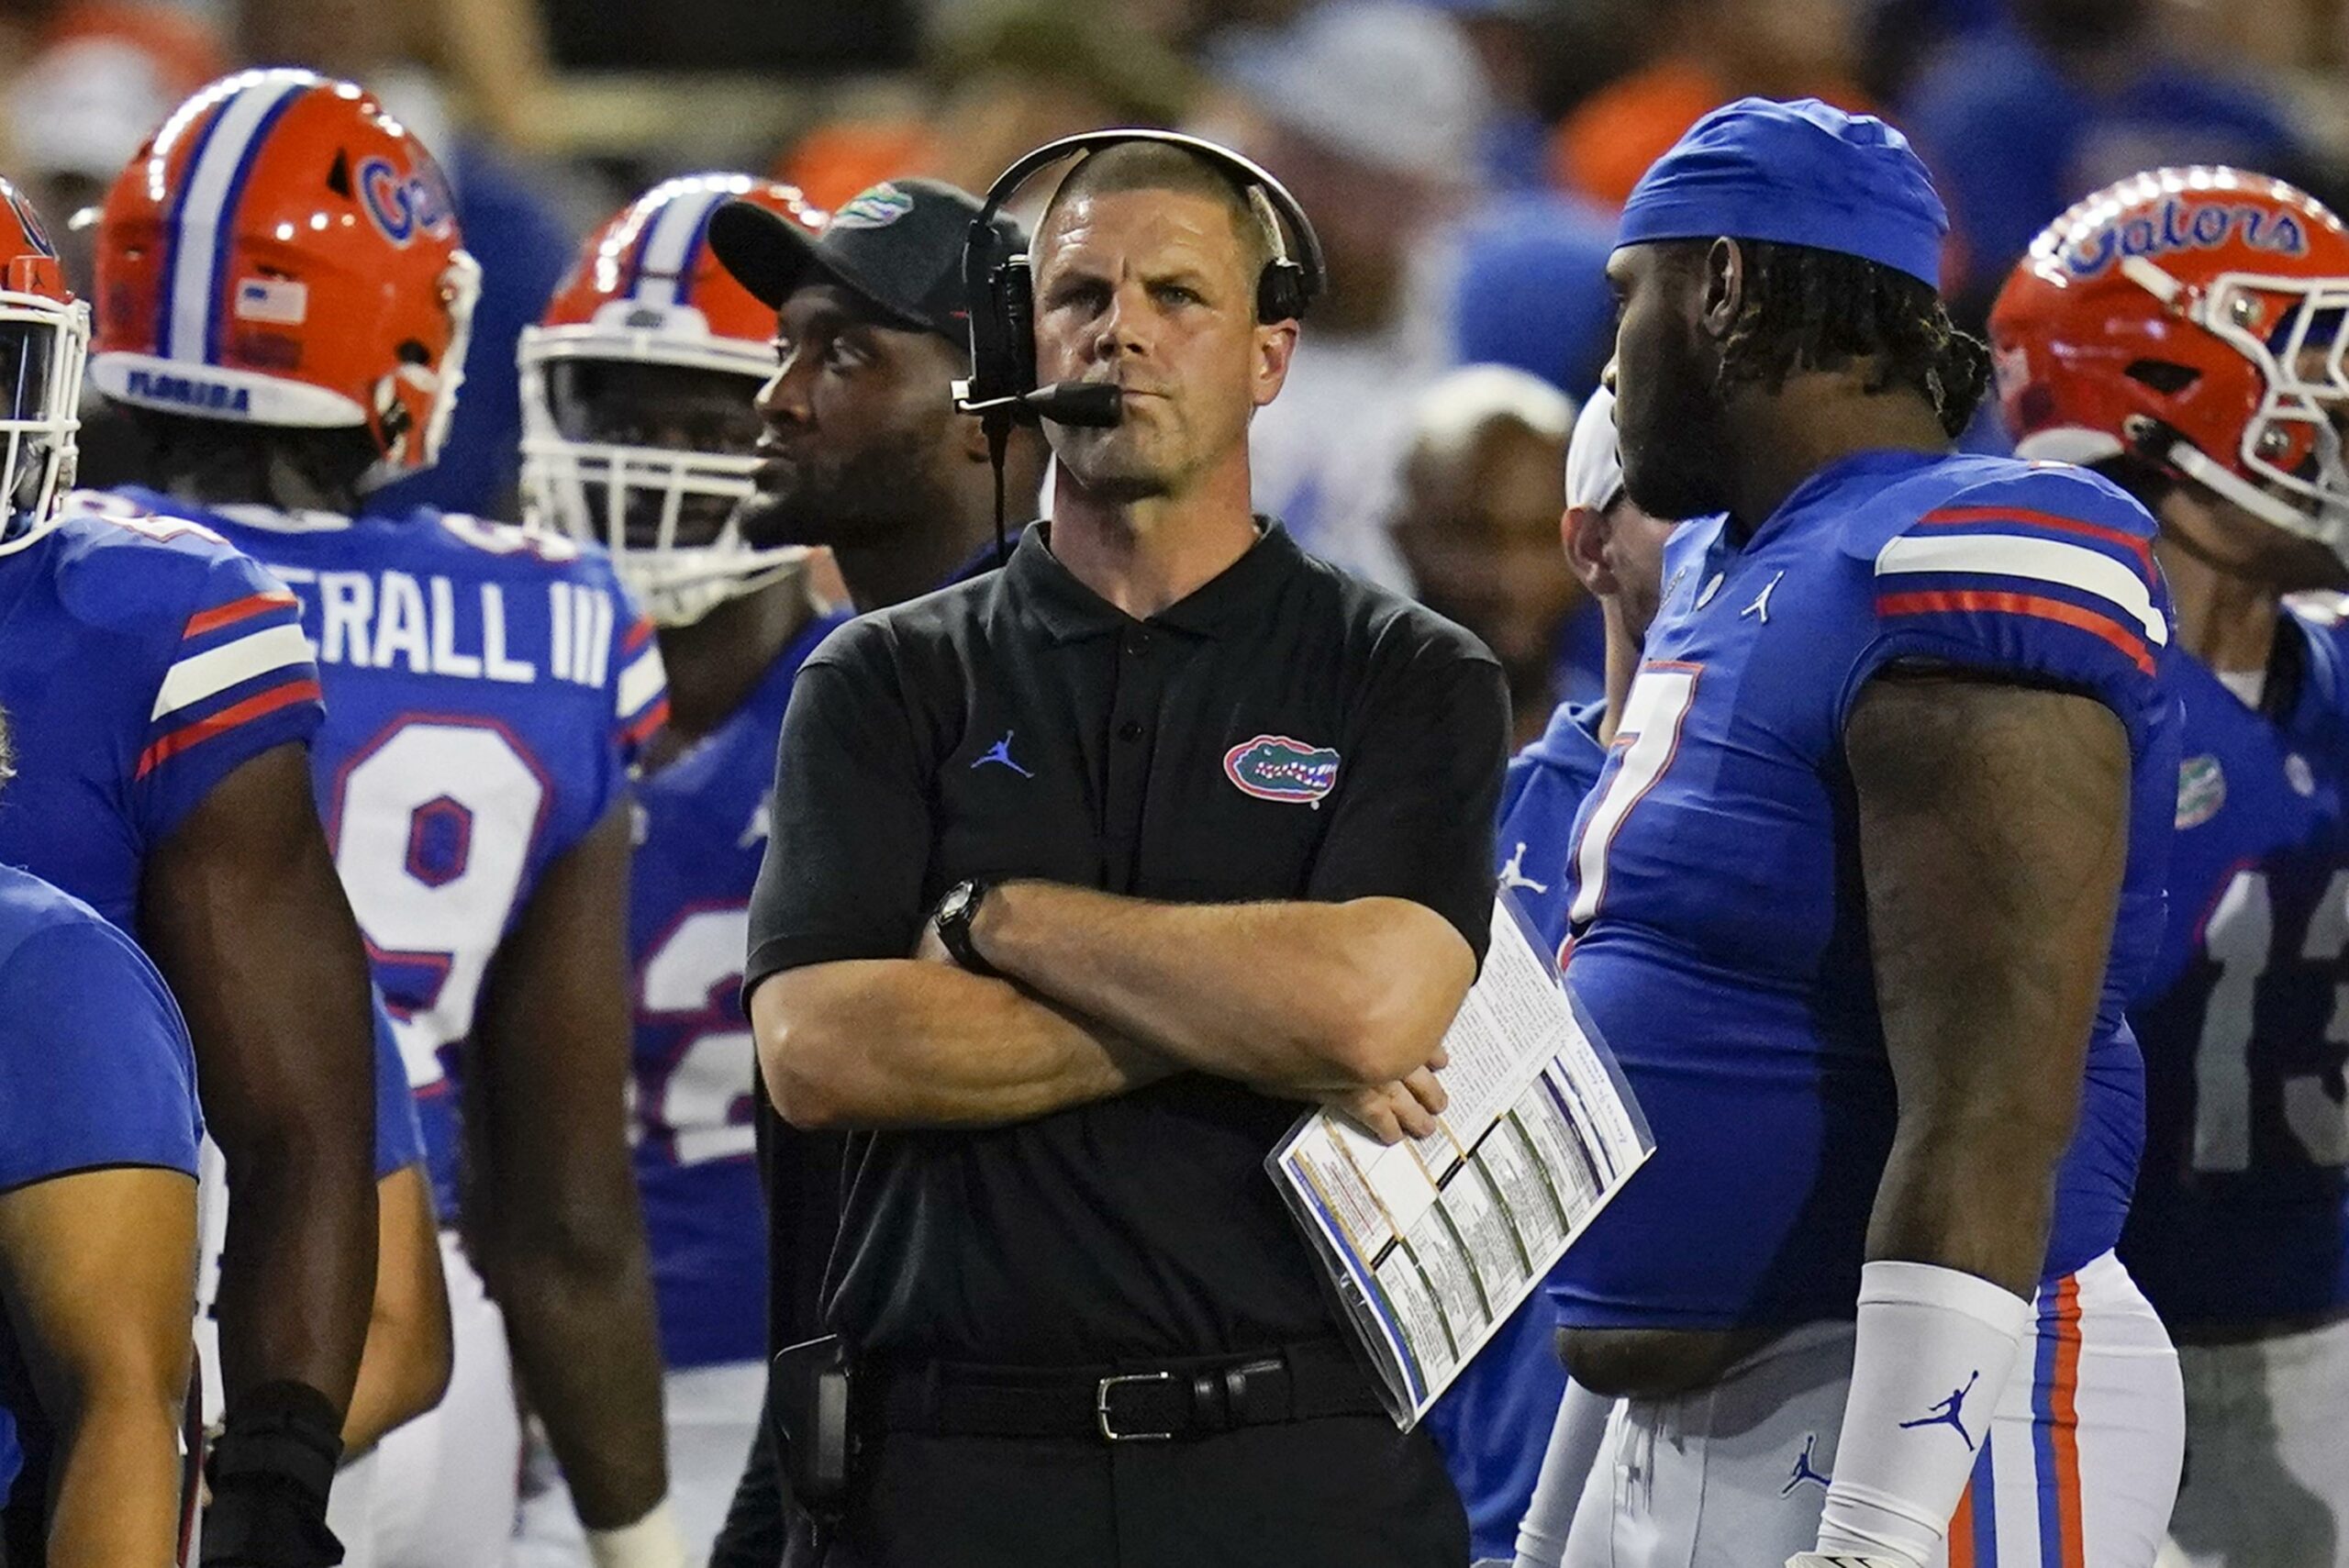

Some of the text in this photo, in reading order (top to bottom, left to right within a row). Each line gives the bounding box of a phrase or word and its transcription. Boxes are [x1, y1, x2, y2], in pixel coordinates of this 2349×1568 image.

[2058, 193, 2310, 278] Gators
[550, 581, 614, 688] III
[1562, 661, 1704, 945] 7
[332, 714, 552, 1097] 9
